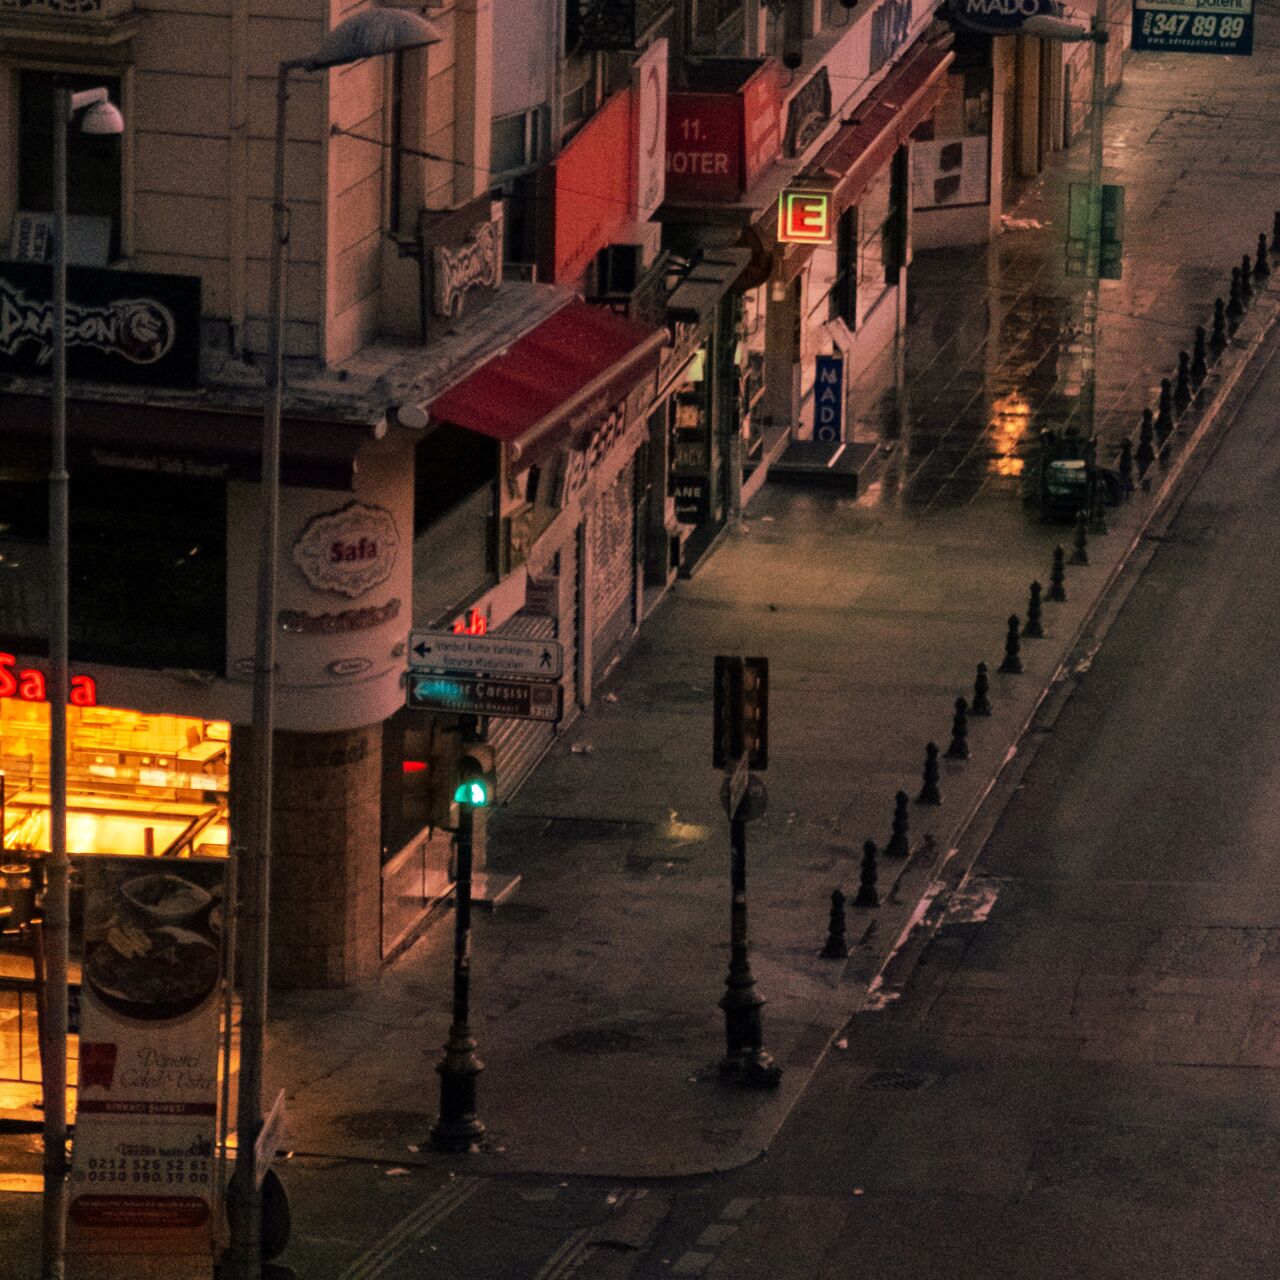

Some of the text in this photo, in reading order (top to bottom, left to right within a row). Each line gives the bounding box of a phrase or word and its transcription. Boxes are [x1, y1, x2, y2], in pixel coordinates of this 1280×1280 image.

[1152, 12, 1190, 38] 347
[1191, 15, 1218, 39] 89
[1218, 16, 1246, 40] 89
[680, 118, 707, 142] 11.
[817, 366, 839, 443] MADO
[331, 536, 378, 563] Safa
[0, 651, 97, 706] Saa
[88, 1159, 127, 1171] 0212
